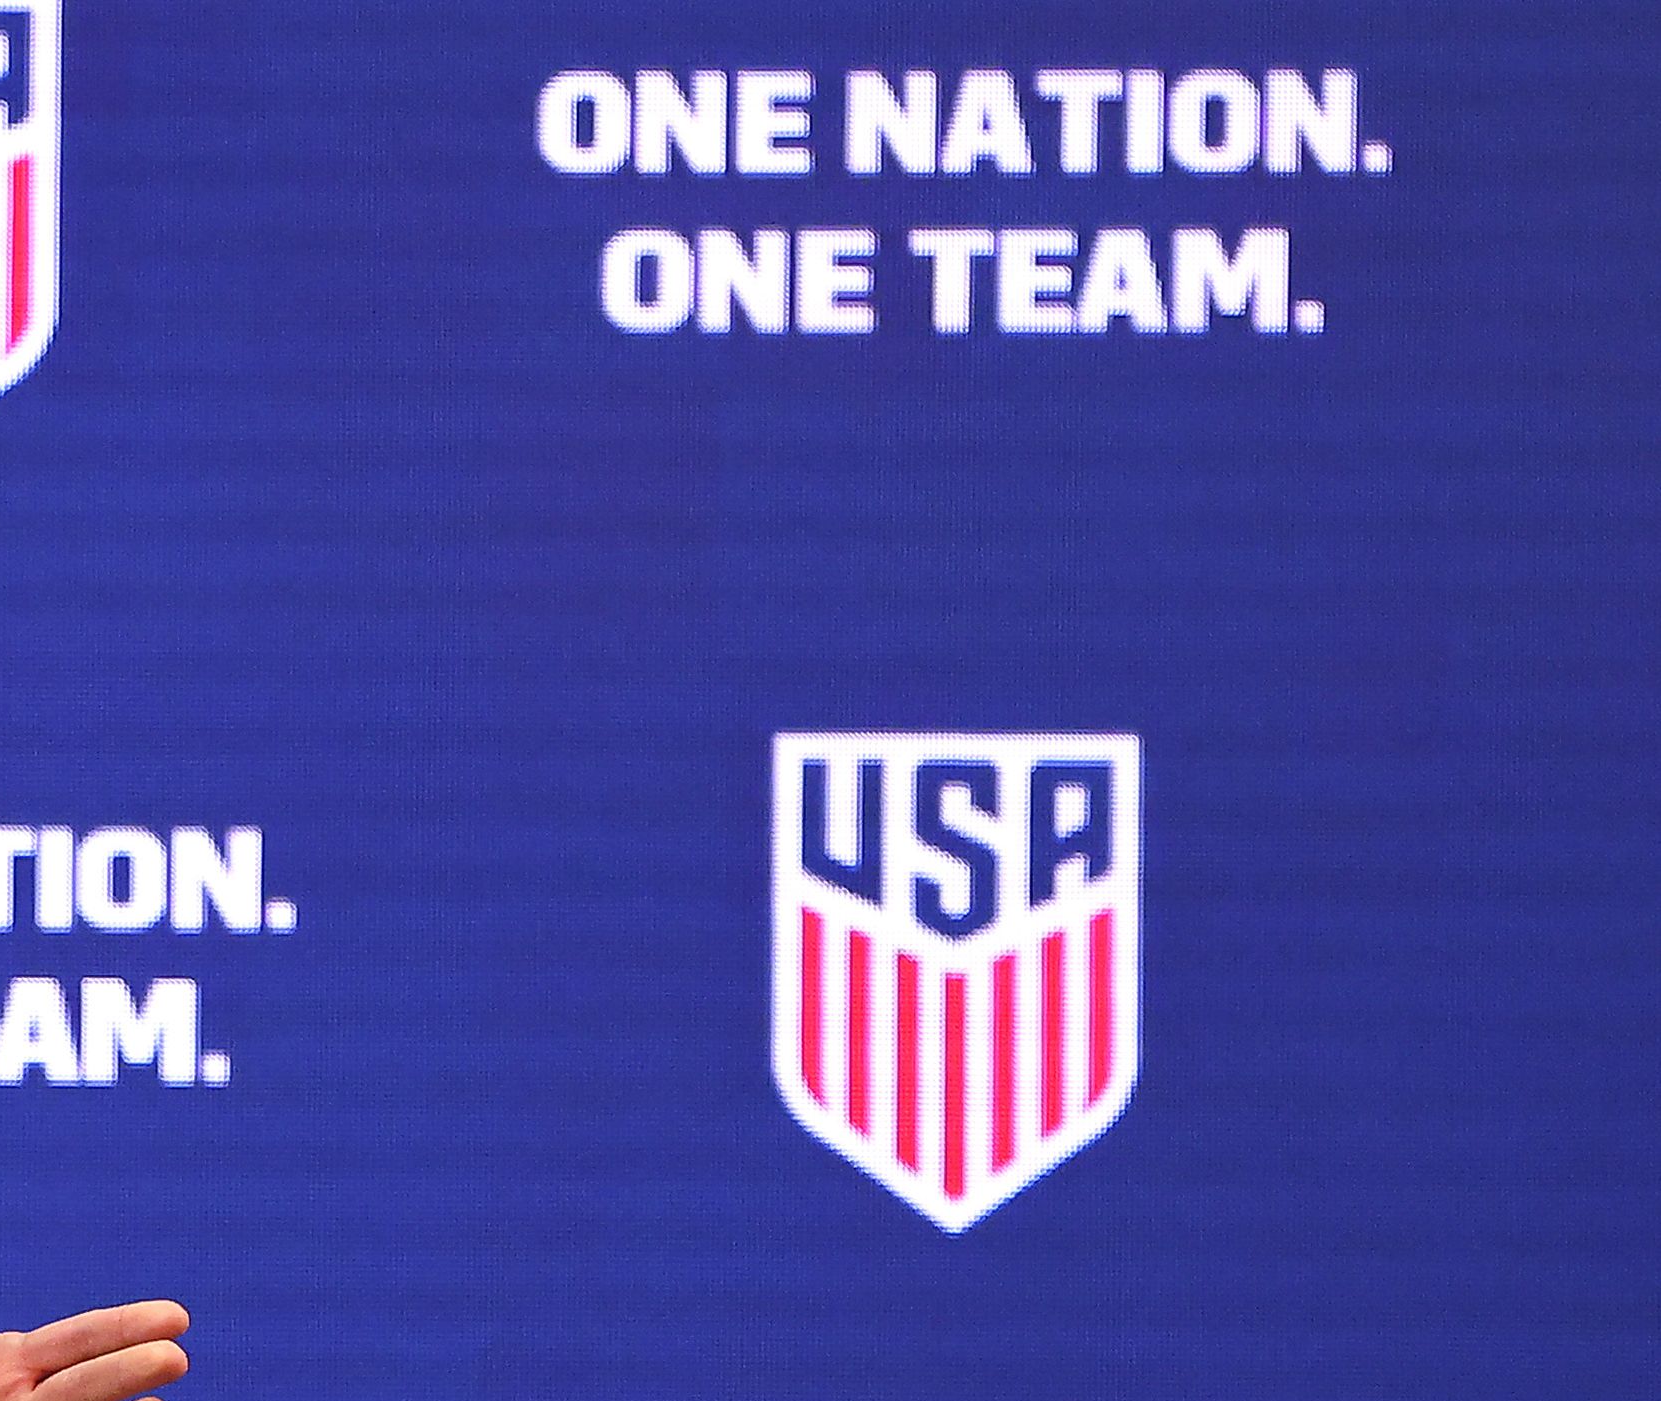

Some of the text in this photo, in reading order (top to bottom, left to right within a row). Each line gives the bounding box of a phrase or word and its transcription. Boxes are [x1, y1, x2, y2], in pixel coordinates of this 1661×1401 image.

[536, 67, 1394, 178] ONE NATION.
[600, 227, 1326, 335] ONE TEAM.
[800, 758, 1113, 941] USA
